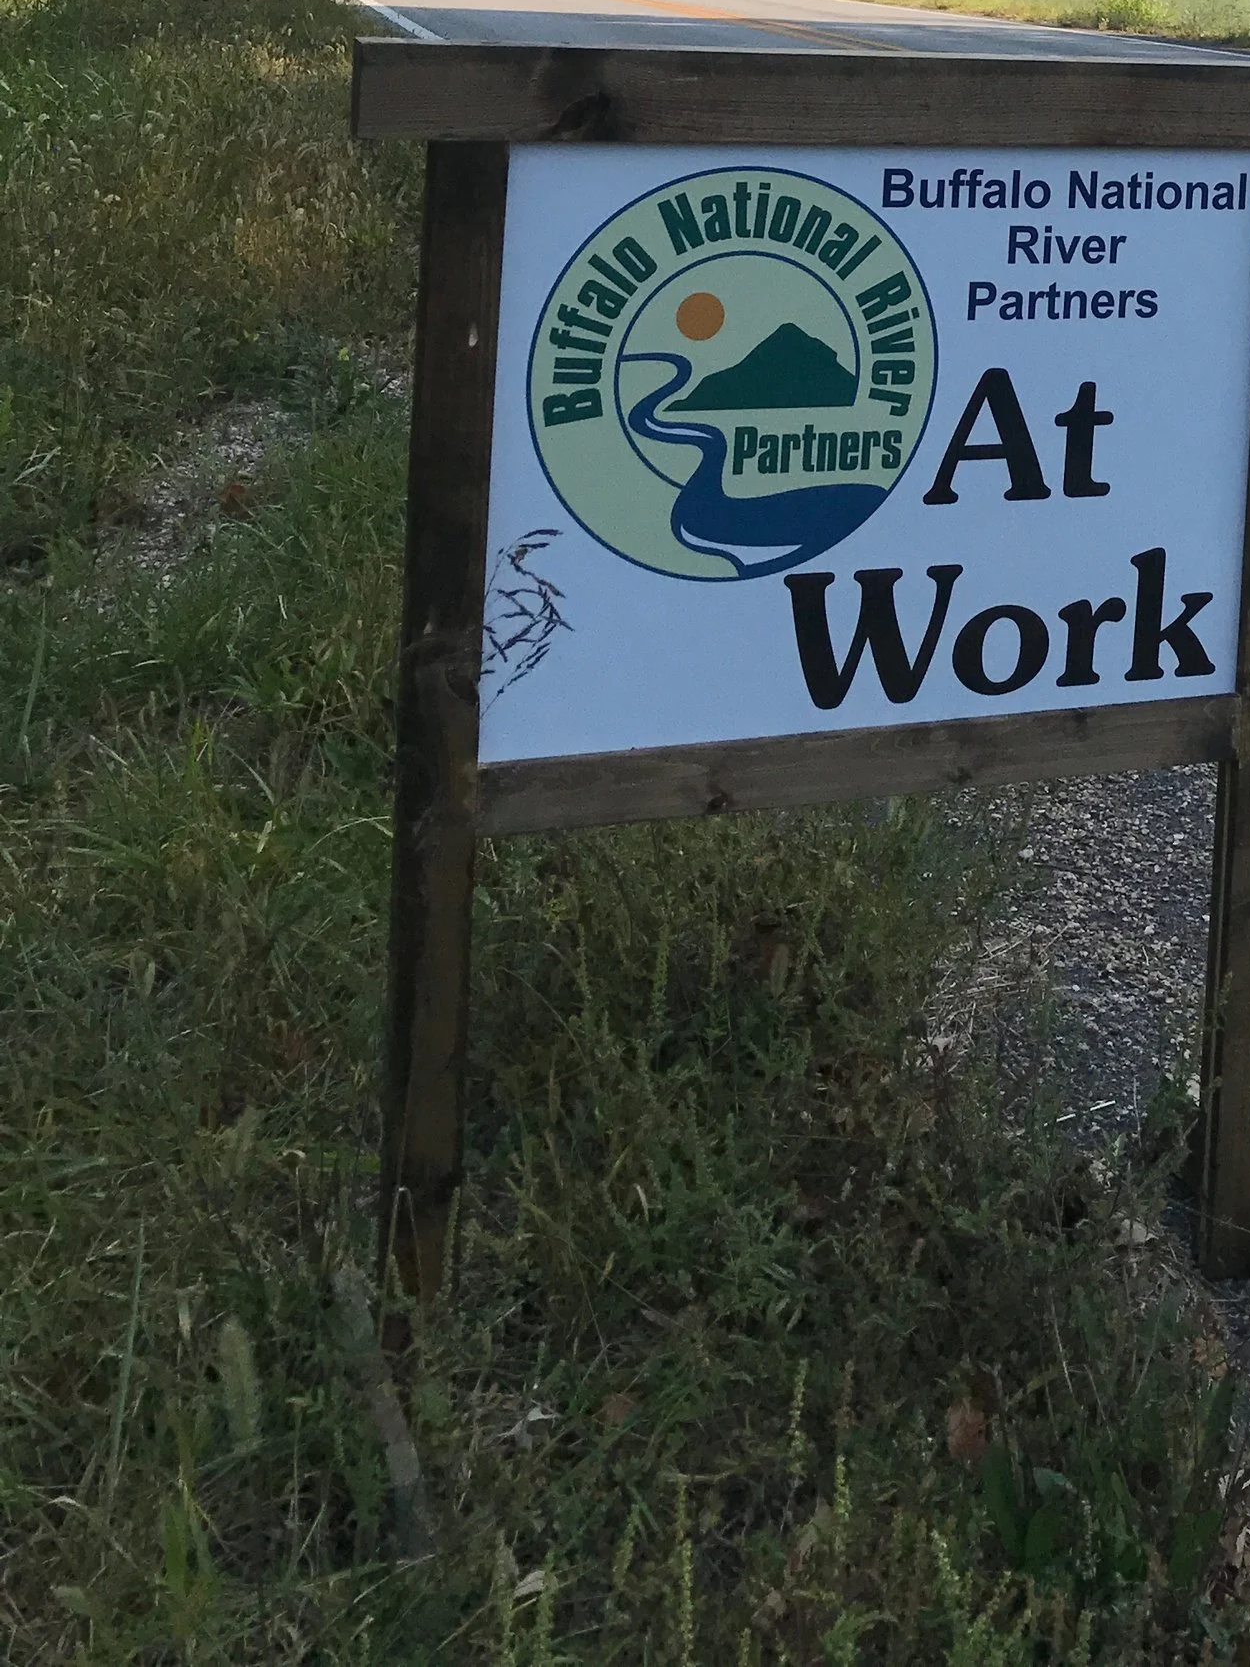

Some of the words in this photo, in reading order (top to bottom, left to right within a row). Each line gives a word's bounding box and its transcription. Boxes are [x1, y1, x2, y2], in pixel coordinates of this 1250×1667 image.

[881, 167, 1052, 210] Buffalo
[1067, 169, 1248, 211] National
[1007, 224, 1128, 265] River
[541, 236, 659, 428] Buffalo
[657, 181, 882, 283] National
[855, 270, 917, 417] River
[966, 281, 1159, 322] Partners
[732, 423, 904, 480] Partners
[922, 367, 1115, 506] At
[783, 546, 1217, 711] Work
